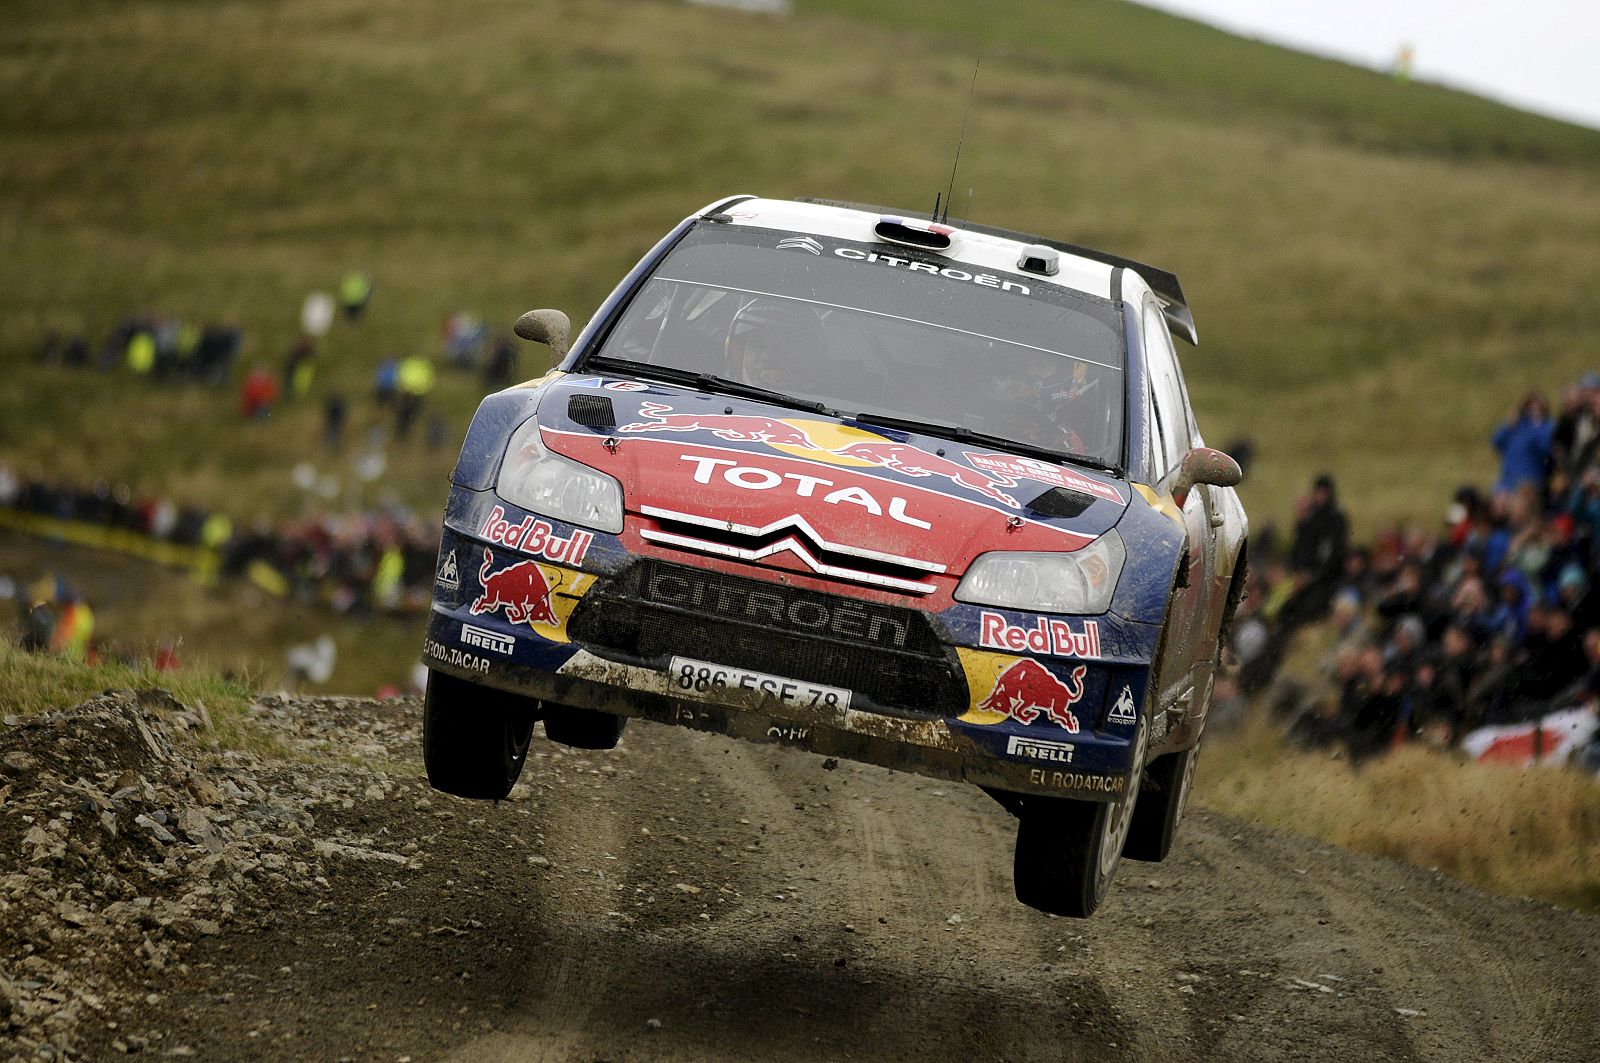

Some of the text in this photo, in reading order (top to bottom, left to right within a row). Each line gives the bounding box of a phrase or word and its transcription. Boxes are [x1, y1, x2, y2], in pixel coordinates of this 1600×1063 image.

[680, 454, 932, 531] TOTAL
[479, 505, 595, 567] Red Bull
[460, 623, 516, 655] PIRELLI
[979, 610, 1101, 659] Red Bull
[678, 664, 728, 693] 886
[1006, 735, 1075, 763] PIRELLI
